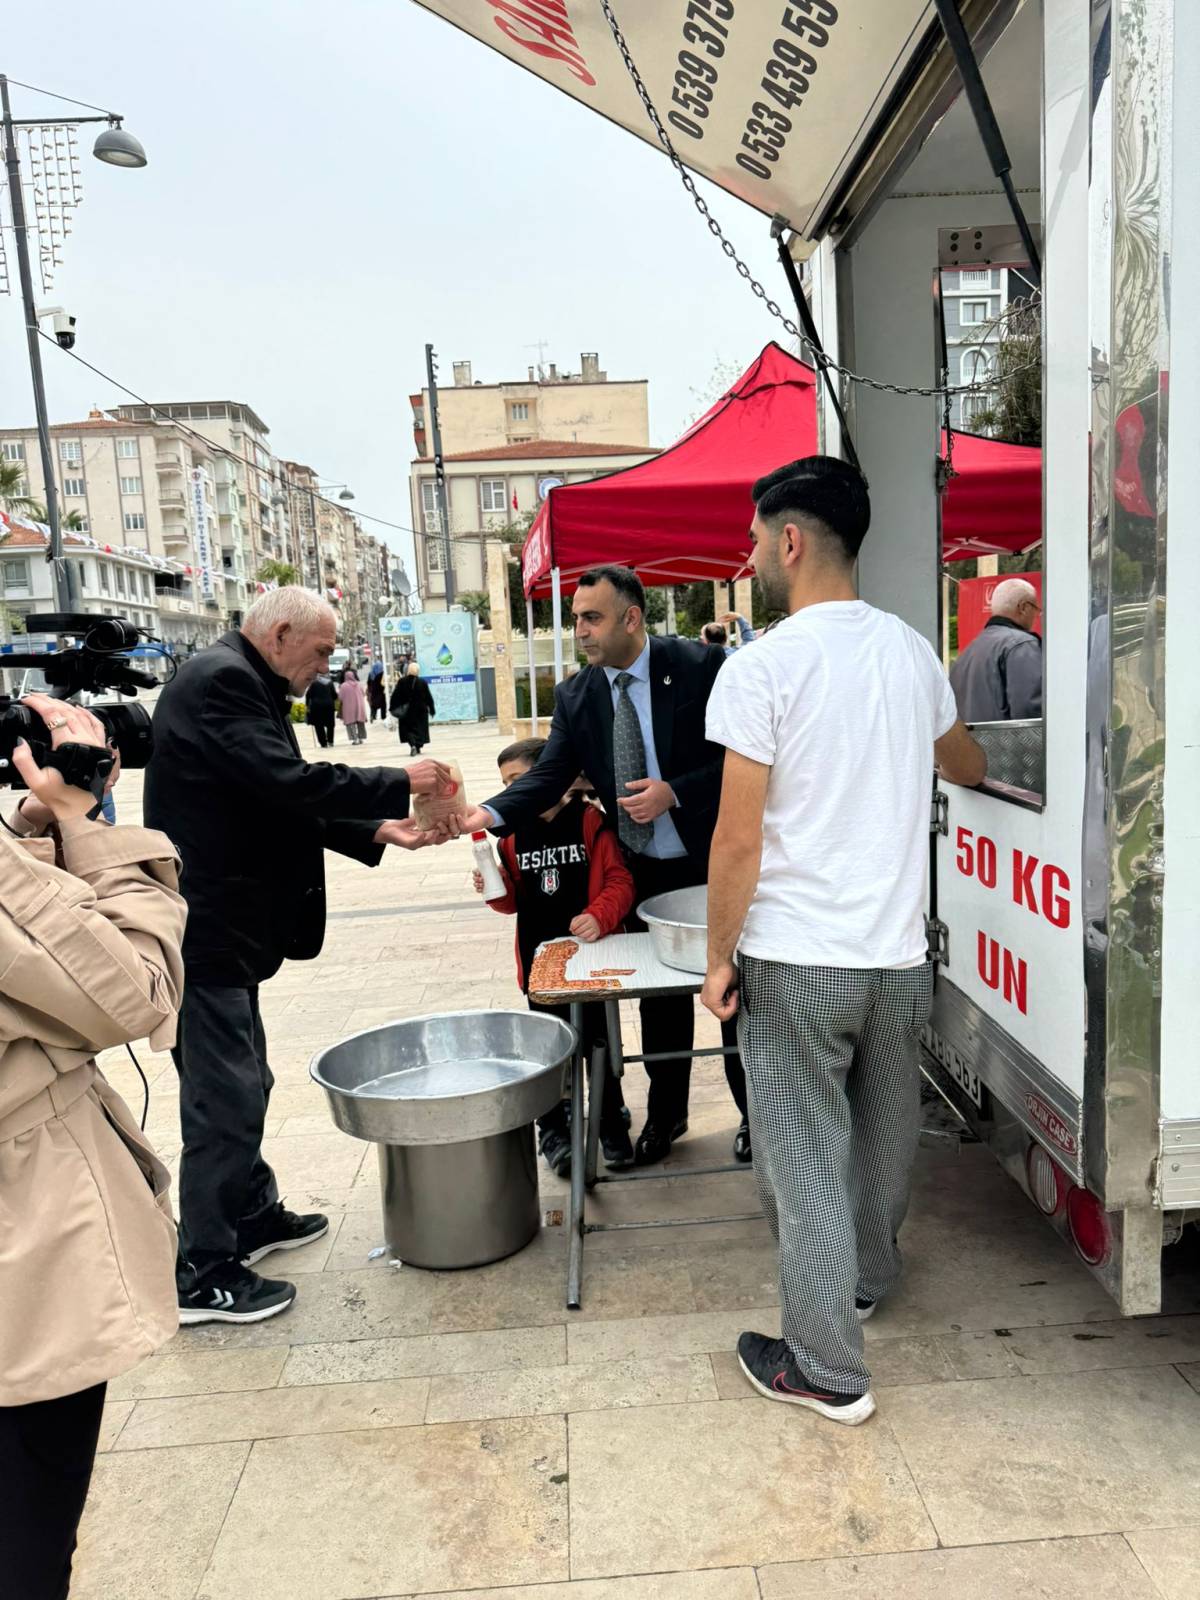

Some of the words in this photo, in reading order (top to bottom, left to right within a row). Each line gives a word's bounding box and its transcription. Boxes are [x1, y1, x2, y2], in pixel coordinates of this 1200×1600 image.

[672, 50, 718, 119] 539
[760, 38, 818, 110] 439
[668, 110, 704, 140] 0
[741, 101, 793, 162] 533
[736, 152, 772, 180] 0
[956, 825, 997, 889] 50
[1013, 848, 1071, 929] KG
[977, 929, 1028, 1016] UN
[1049, 1117, 1071, 1147] CASE
